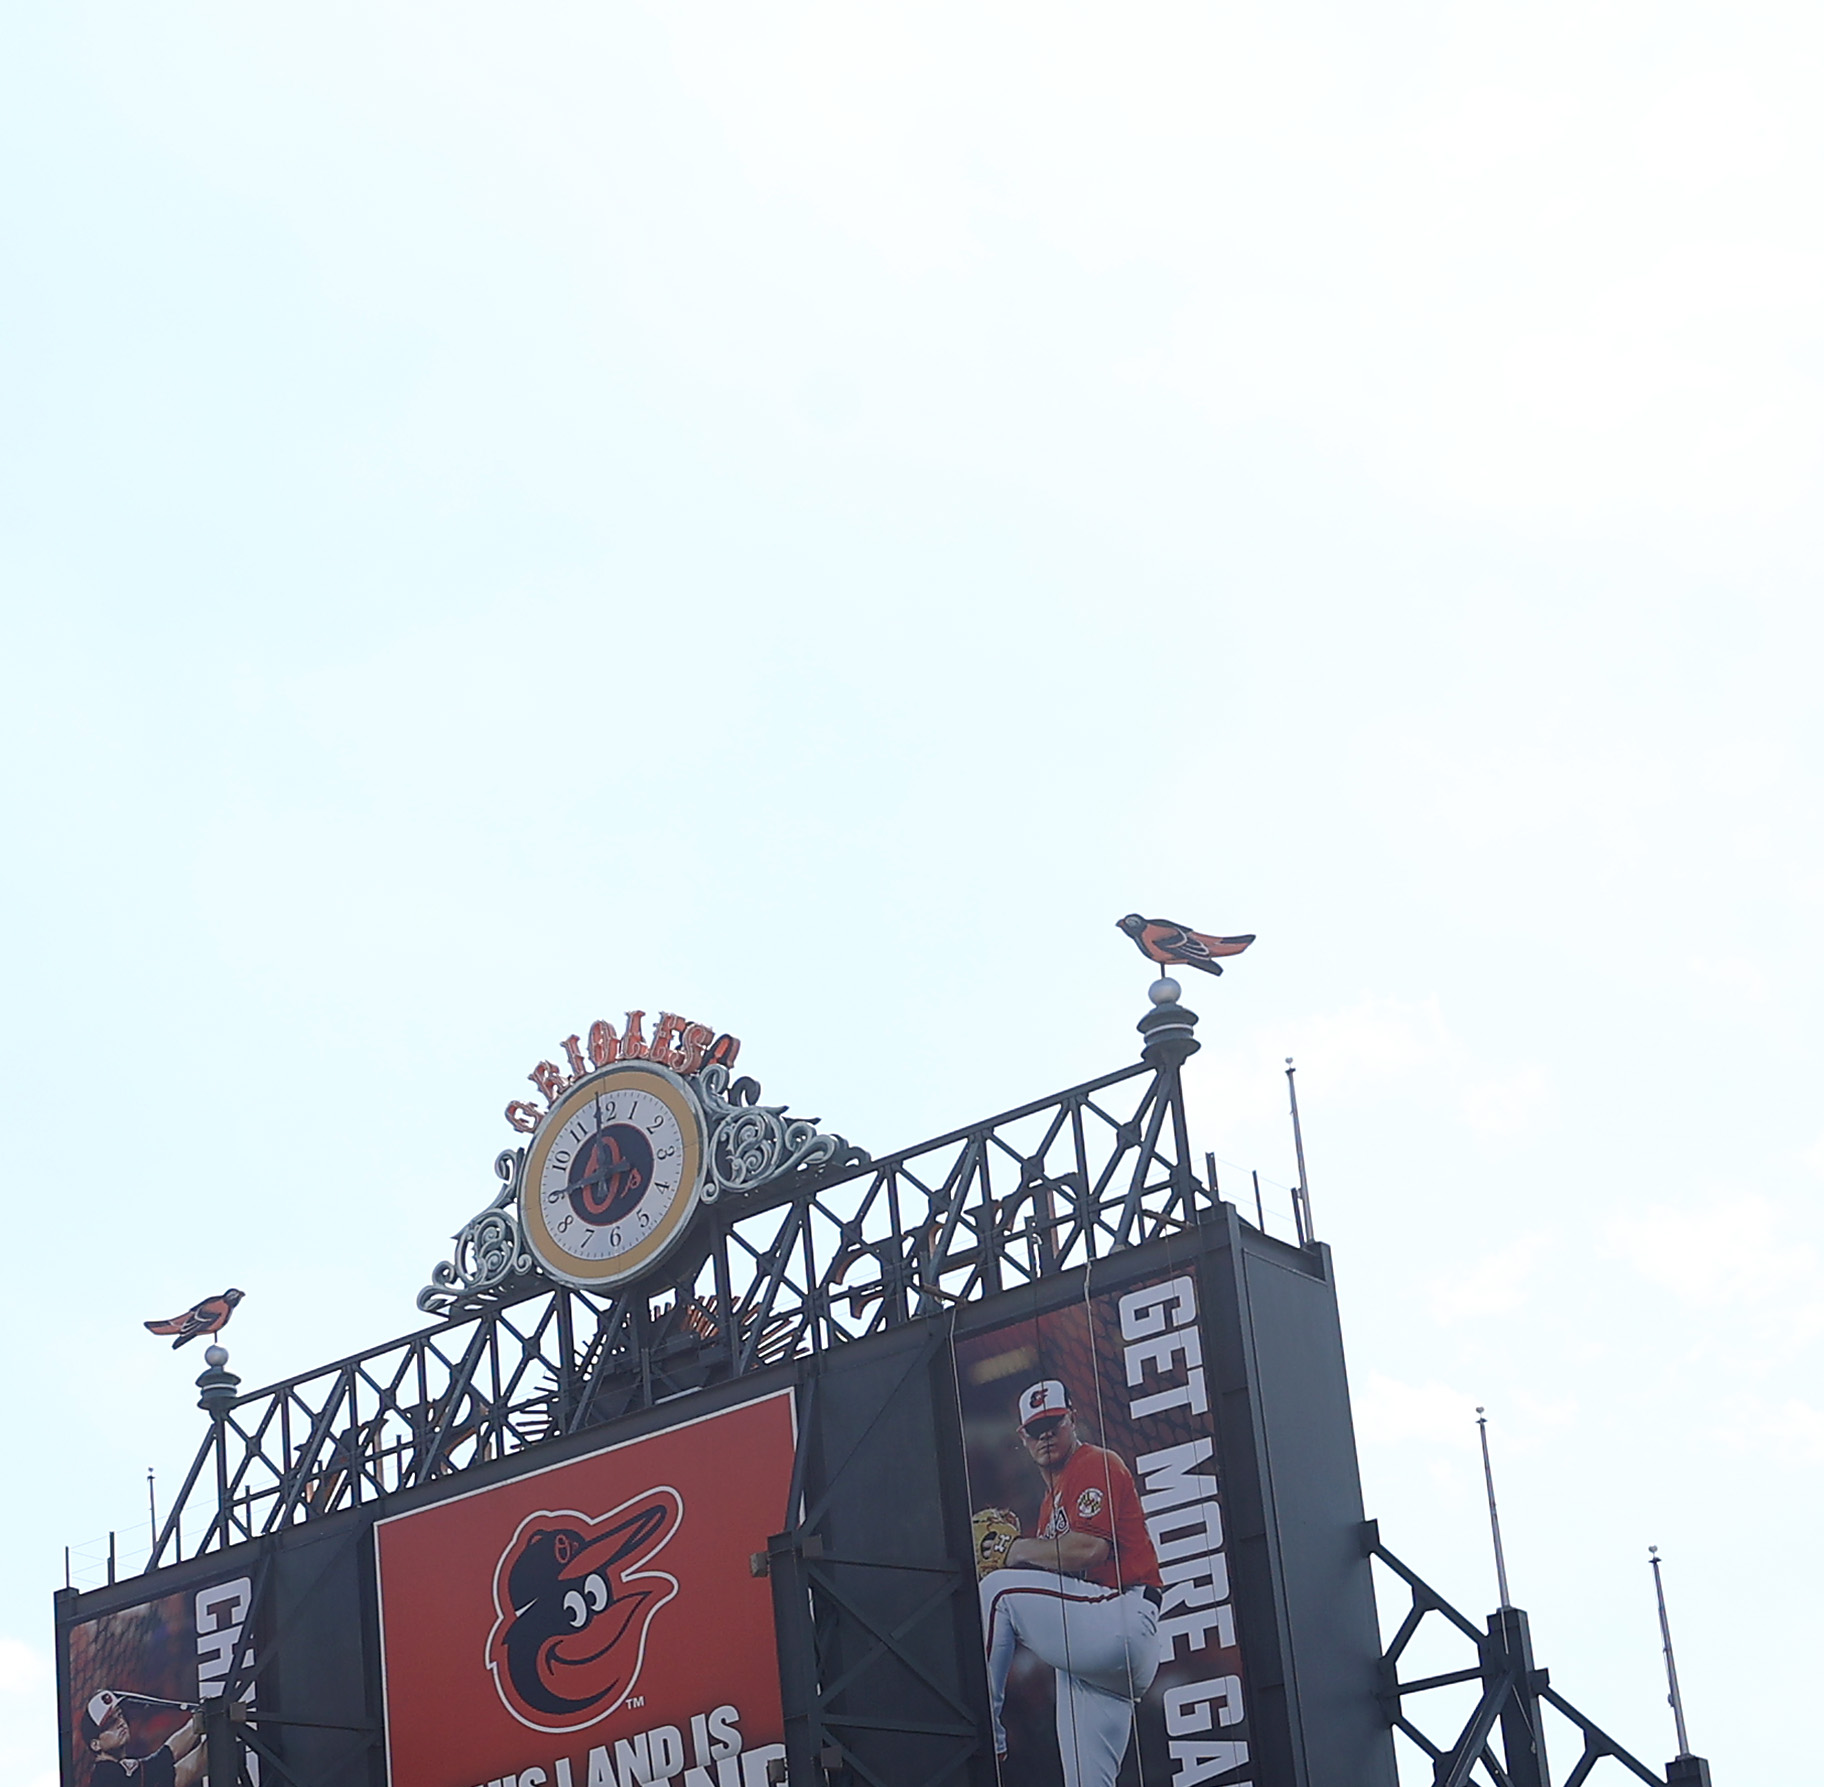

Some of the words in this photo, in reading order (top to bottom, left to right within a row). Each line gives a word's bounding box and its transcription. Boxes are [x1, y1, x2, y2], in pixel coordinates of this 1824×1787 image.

[504, 1009, 716, 1133] ORIOLES
[628, 1100, 638, 1120] 1
[569, 1120, 590, 1144] 11
[646, 1115, 664, 1134] 2
[553, 1150, 571, 1173] 10
[656, 1145, 676, 1161] 3
[654, 1180, 671, 1195] 4
[556, 1215, 574, 1234] 8
[636, 1209, 651, 1229] 5
[580, 1228, 595, 1249] 7
[608, 1226, 622, 1247] 6
[1119, 1275, 1210, 1420] GET
[1136, 1451, 1237, 1664] MORE
[625, 1696, 646, 1710] TM
[690, 1704, 743, 1767] IS
